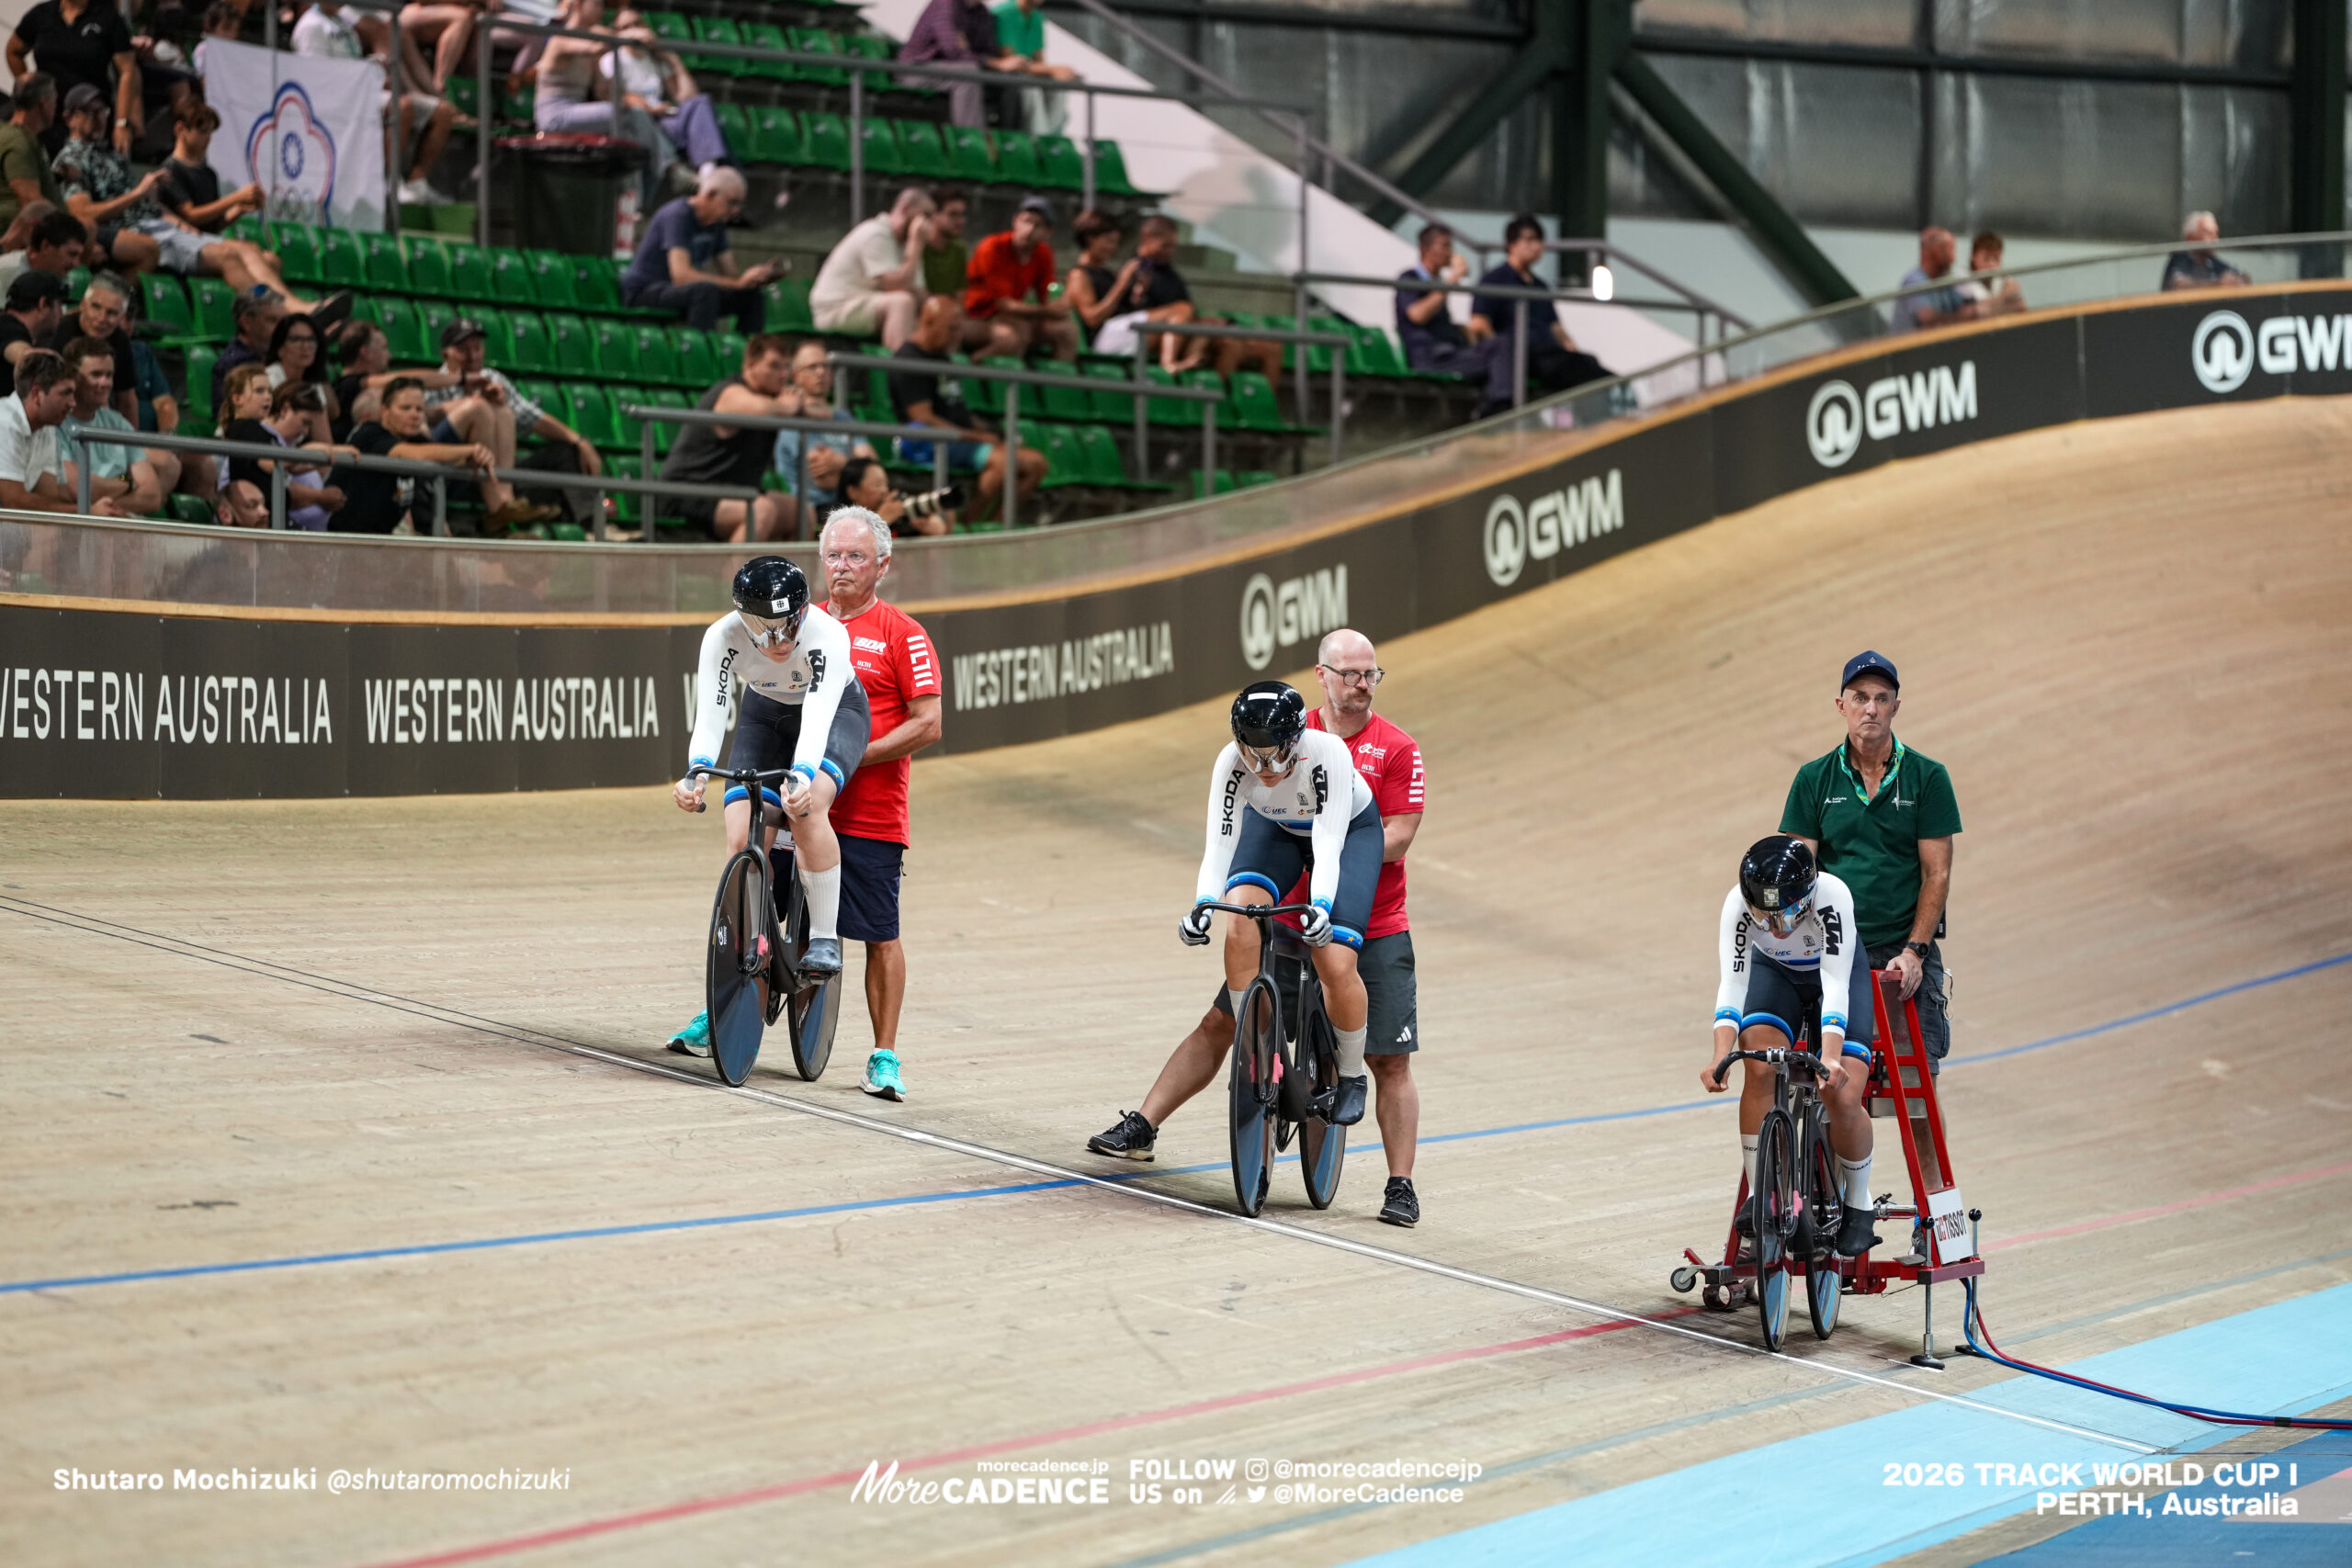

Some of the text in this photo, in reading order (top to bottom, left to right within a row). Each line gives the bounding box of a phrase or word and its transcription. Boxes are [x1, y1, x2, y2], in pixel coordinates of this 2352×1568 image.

[1865, 362, 1978, 440] GWM
[1528, 468, 1625, 560] GWM
[1276, 563, 1349, 647] GWM
[808, 649, 826, 693] KTM
[954, 645, 1057, 711] WESTERN
[1062, 621, 1173, 694] AUSTRALIA
[154, 674, 333, 744] AUSTRALIA
[366, 678, 503, 744] WESTERN
[510, 676, 660, 741] AUSTRALIA
[1312, 764, 1329, 815] KTM
[1816, 905, 1843, 956] KTM
[1942, 1210, 1968, 1240] TISSOT
